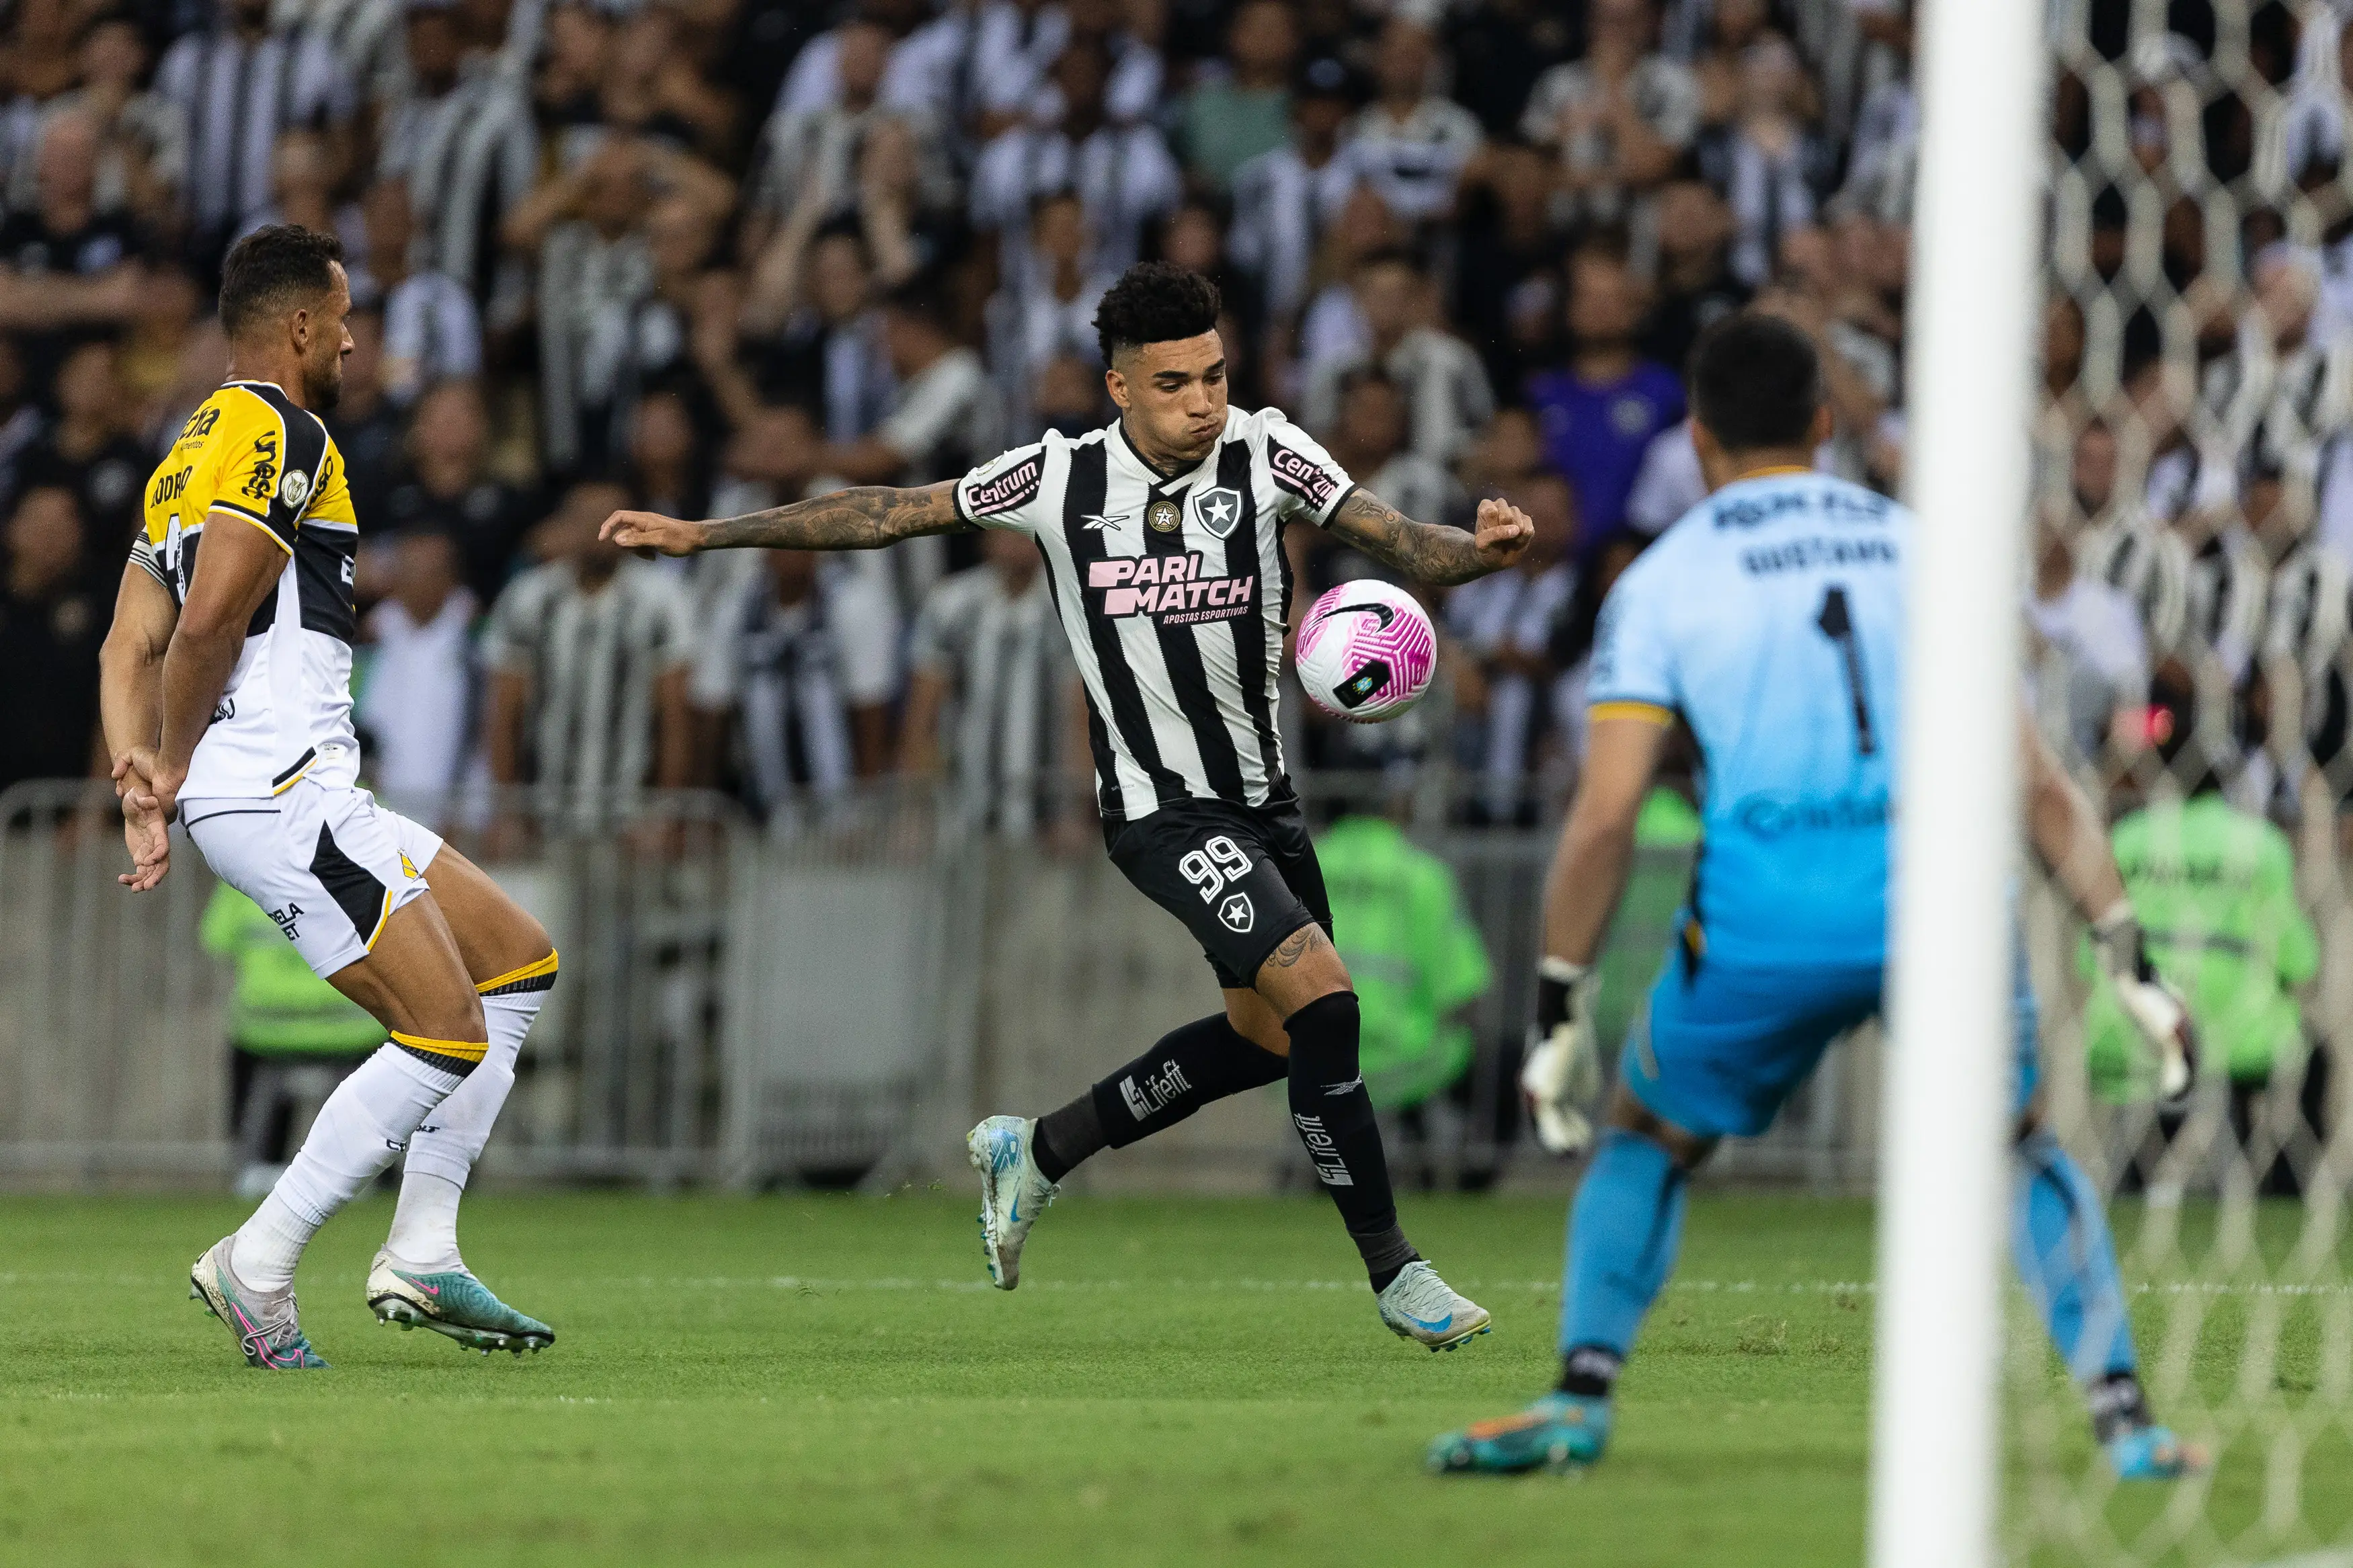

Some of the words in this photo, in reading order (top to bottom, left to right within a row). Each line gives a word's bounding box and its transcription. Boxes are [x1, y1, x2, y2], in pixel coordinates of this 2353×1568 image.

[967, 462, 1037, 506] Centrum
[1088, 554, 1199, 587] PARI
[1104, 575, 1254, 614] MATCH
[1163, 612, 1199, 625] APOSTAS
[1200, 606, 1248, 621] ESPORTIVAS
[1817, 583, 1877, 755] 1
[1179, 835, 1253, 905] 99
